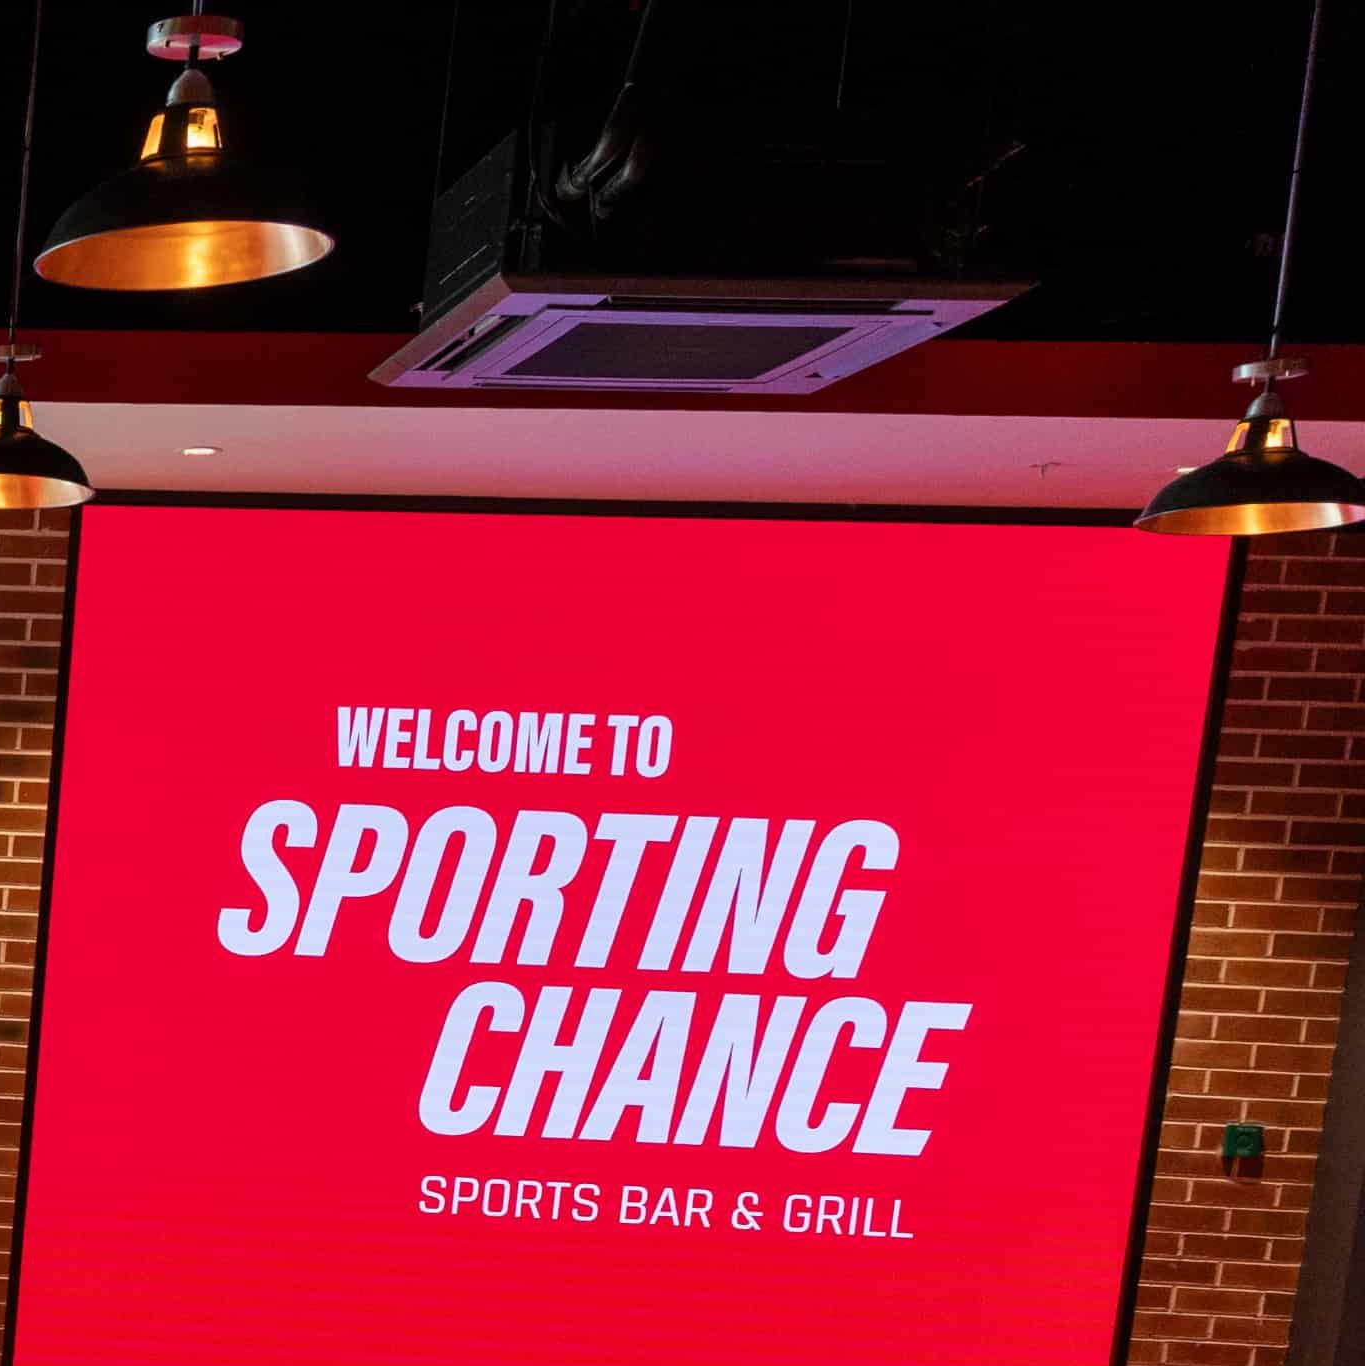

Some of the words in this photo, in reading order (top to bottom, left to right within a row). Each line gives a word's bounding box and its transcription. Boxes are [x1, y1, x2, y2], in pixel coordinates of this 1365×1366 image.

[337, 706, 596, 775] WELCOME
[607, 714, 673, 778] TO
[217, 799, 900, 979] SPORTING
[418, 981, 973, 1156] CHANCE
[419, 1175, 600, 1222] SPORTS
[619, 1185, 713, 1228] BAR
[731, 1191, 763, 1231] &
[783, 1194, 914, 1238] GRILL
